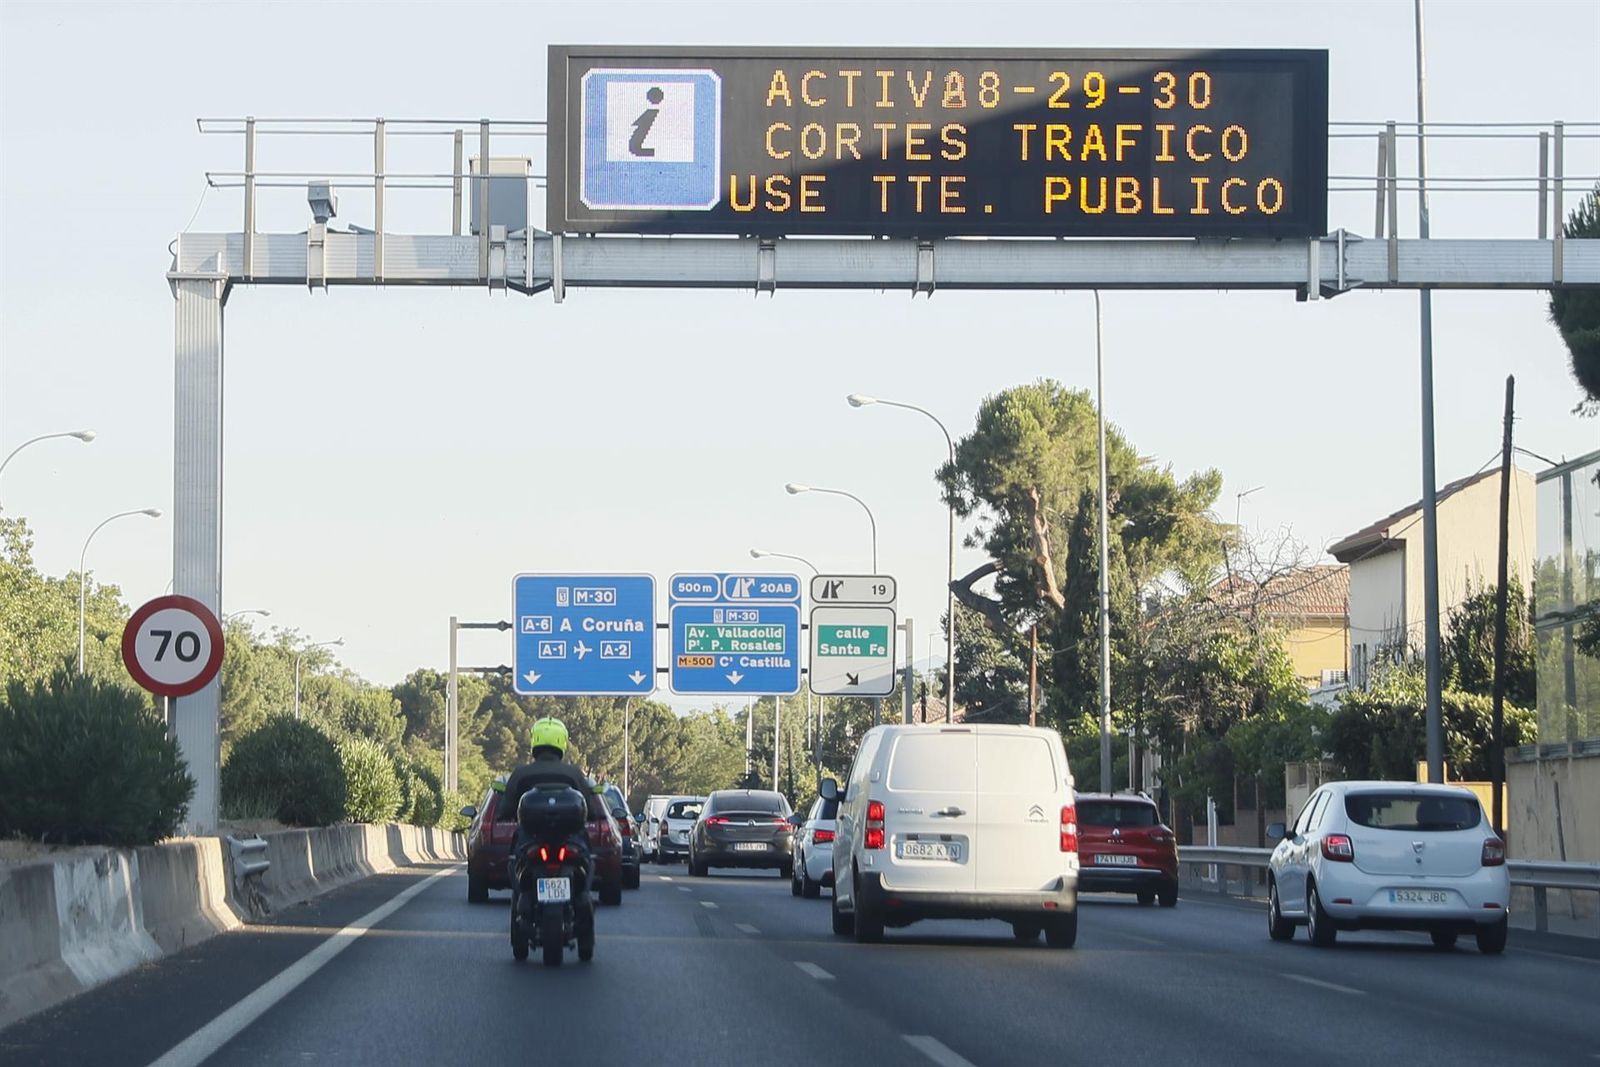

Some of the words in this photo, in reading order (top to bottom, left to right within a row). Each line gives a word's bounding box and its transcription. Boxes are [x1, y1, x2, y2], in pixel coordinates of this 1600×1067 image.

[764, 122, 968, 161] CORTES
[1012, 124, 1249, 162] TRAFICO
[729, 174, 827, 213] USE
[872, 175, 994, 214] TTE.
[1044, 176, 1284, 215] PUBLICO
[760, 583, 793, 593] 20AB
[871, 584, 887, 596] 19
[576, 590, 614, 603] M-30
[728, 611, 757, 621] M-30
[524, 618, 550, 631] A-6
[559, 617, 573, 632] A
[582, 616, 645, 632] Coruña
[688, 627, 710, 638] Av.
[717, 626, 783, 639] Valladolid
[835, 626, 870, 639] calle
[150, 630, 201, 662] 70
[542, 643, 564, 656] A-1
[603, 643, 628, 656] A-2
[711, 640, 724, 651] P.
[731, 639, 783, 651] Rosales
[820, 643, 862, 656] Santa
[869, 643, 886, 656] Fe
[678, 656, 714, 666] M-500
[740, 655, 791, 668] Castilla
[905, 843, 933, 856] 0682
[1396, 890, 1424, 902] 5324
